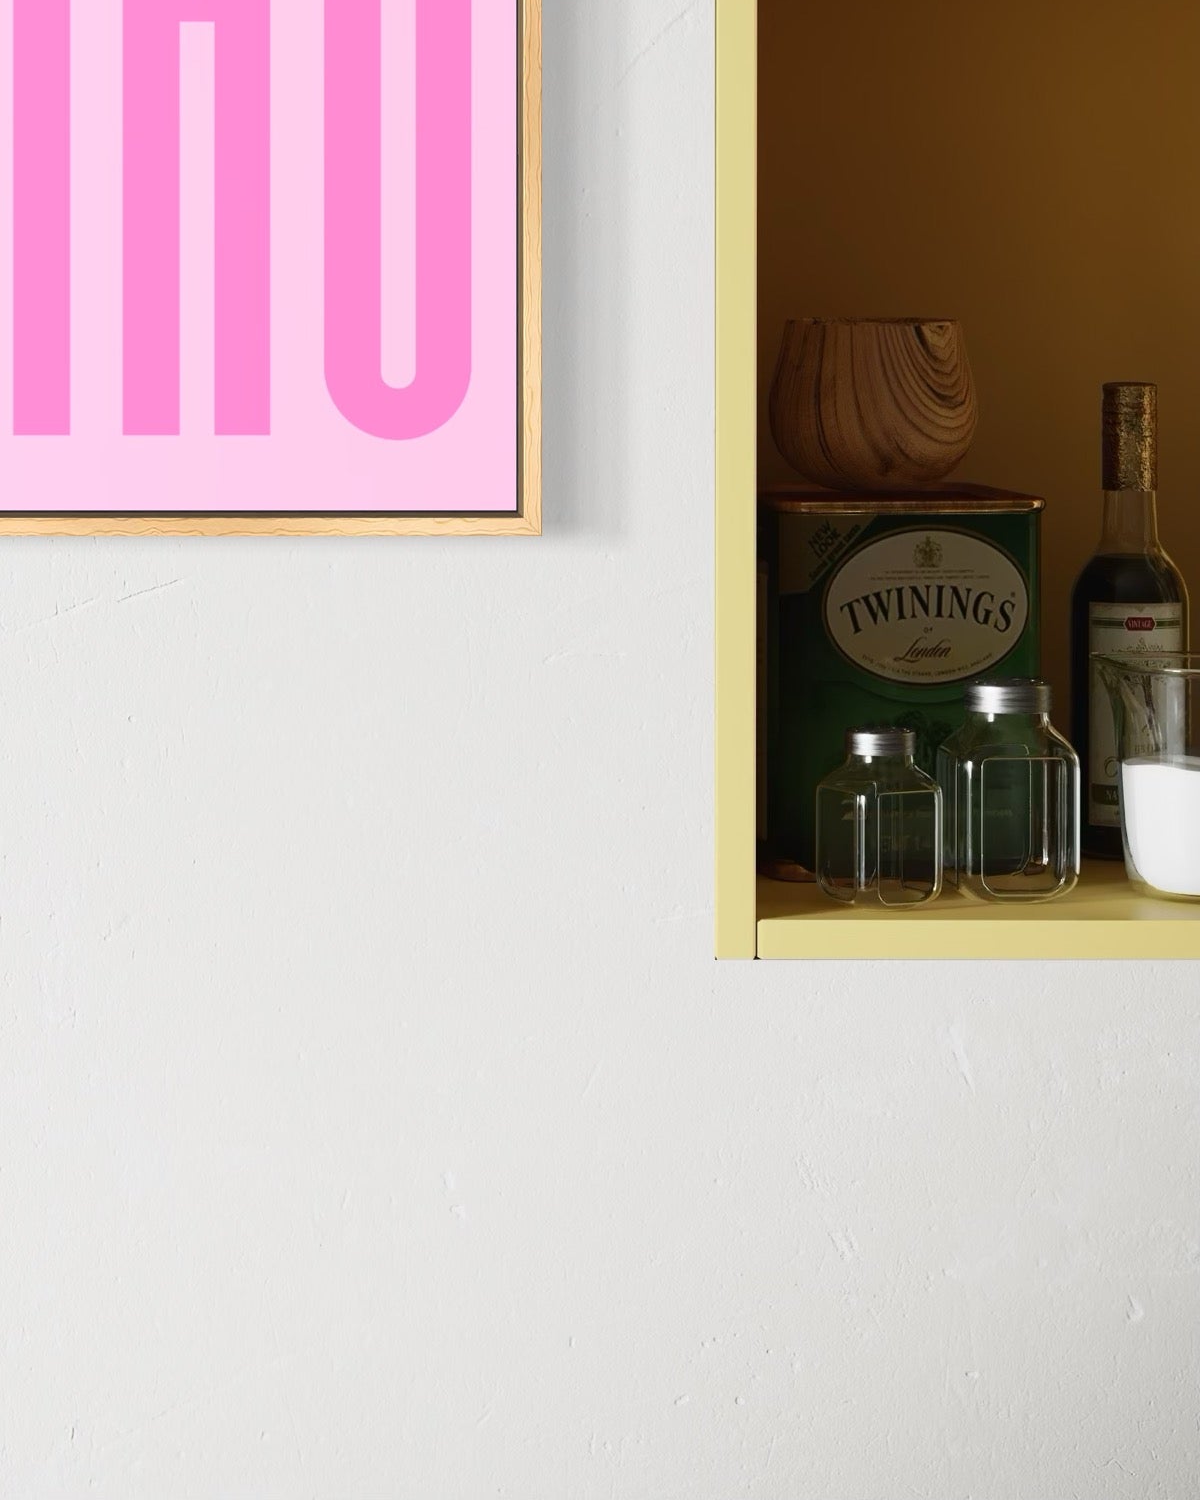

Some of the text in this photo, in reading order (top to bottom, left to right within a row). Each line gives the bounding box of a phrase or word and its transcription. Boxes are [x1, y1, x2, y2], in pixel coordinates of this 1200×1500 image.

[840, 584, 1016, 634] TWININGS
[1127, 619, 1153, 628] VINTAGE
[893, 636, 951, 663] London
